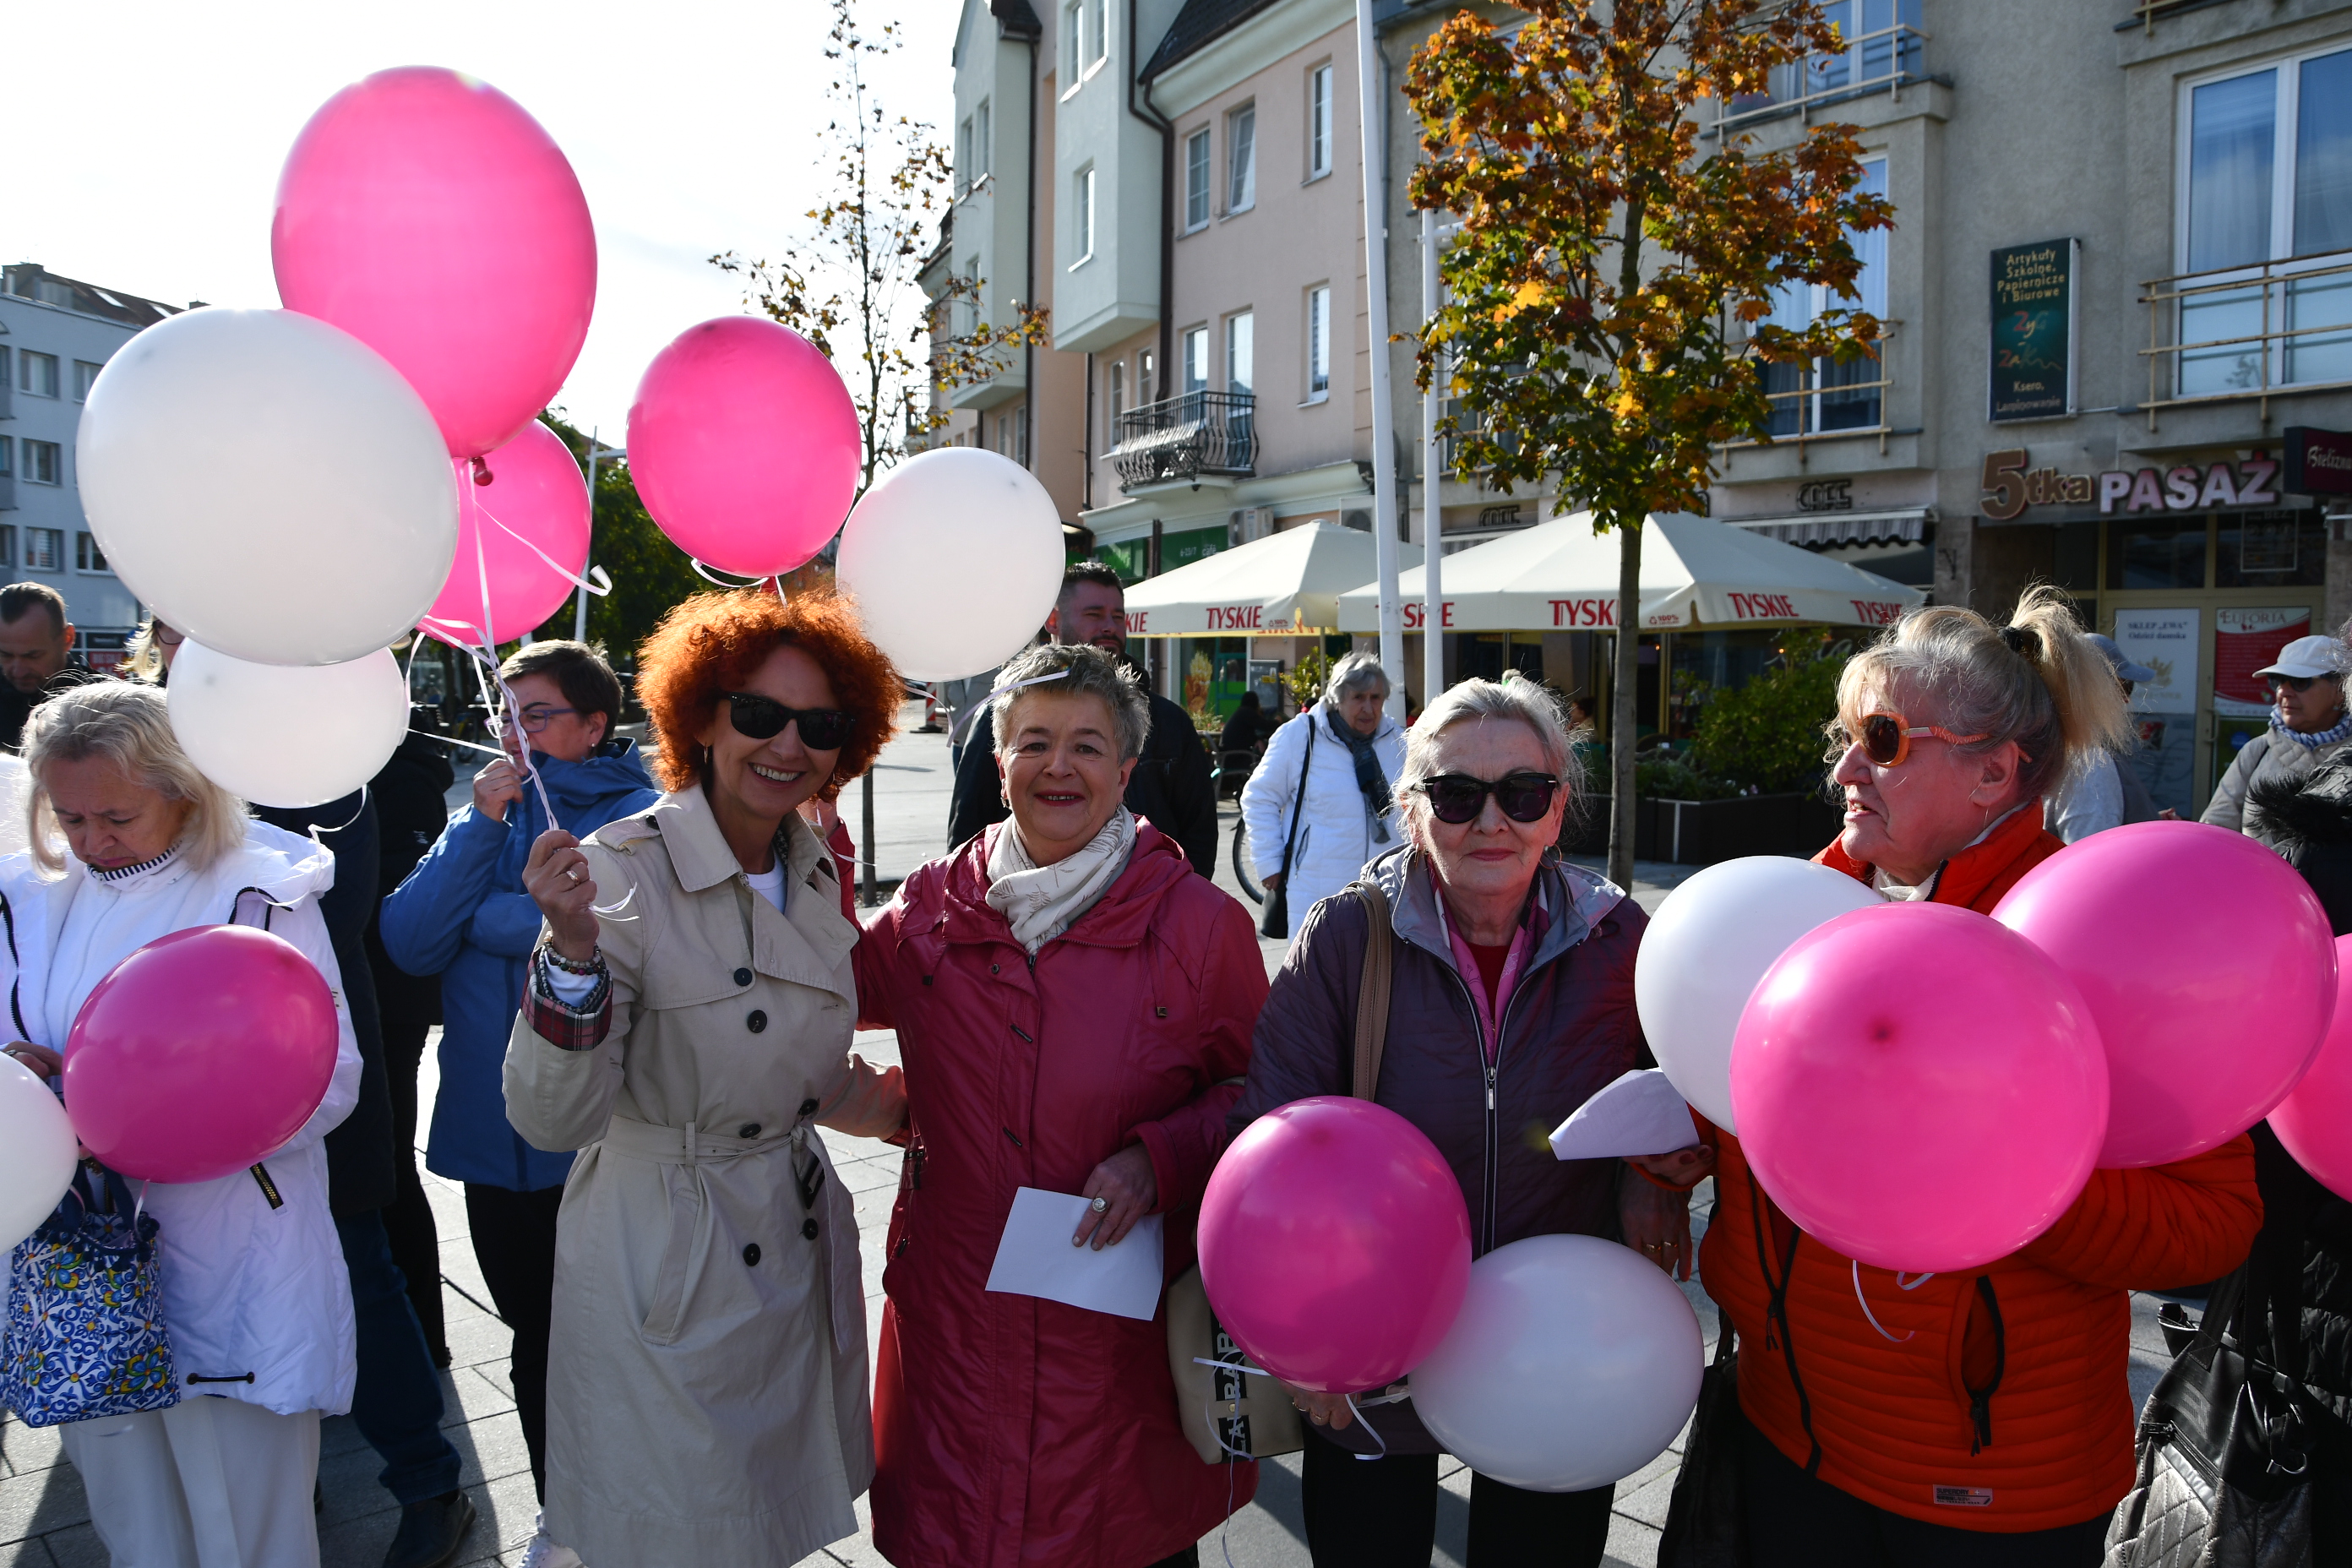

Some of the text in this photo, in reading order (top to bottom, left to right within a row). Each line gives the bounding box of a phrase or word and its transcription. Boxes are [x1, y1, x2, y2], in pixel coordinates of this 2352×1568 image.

[2006, 248, 2056, 266] Artykuły
[1997, 274, 2065, 293] Papiernicze
[2012, 287, 2060, 302] Biurowe
[1980, 448, 2278, 520] 5tka PASAŻ
[1548, 599, 1641, 626] TYSK
[1728, 593, 1799, 618] TYSKIE
[1124, 612, 1148, 633] KIE
[1206, 606, 1263, 629] TYSKIE
[1223, 1361, 1248, 1456] LARA
